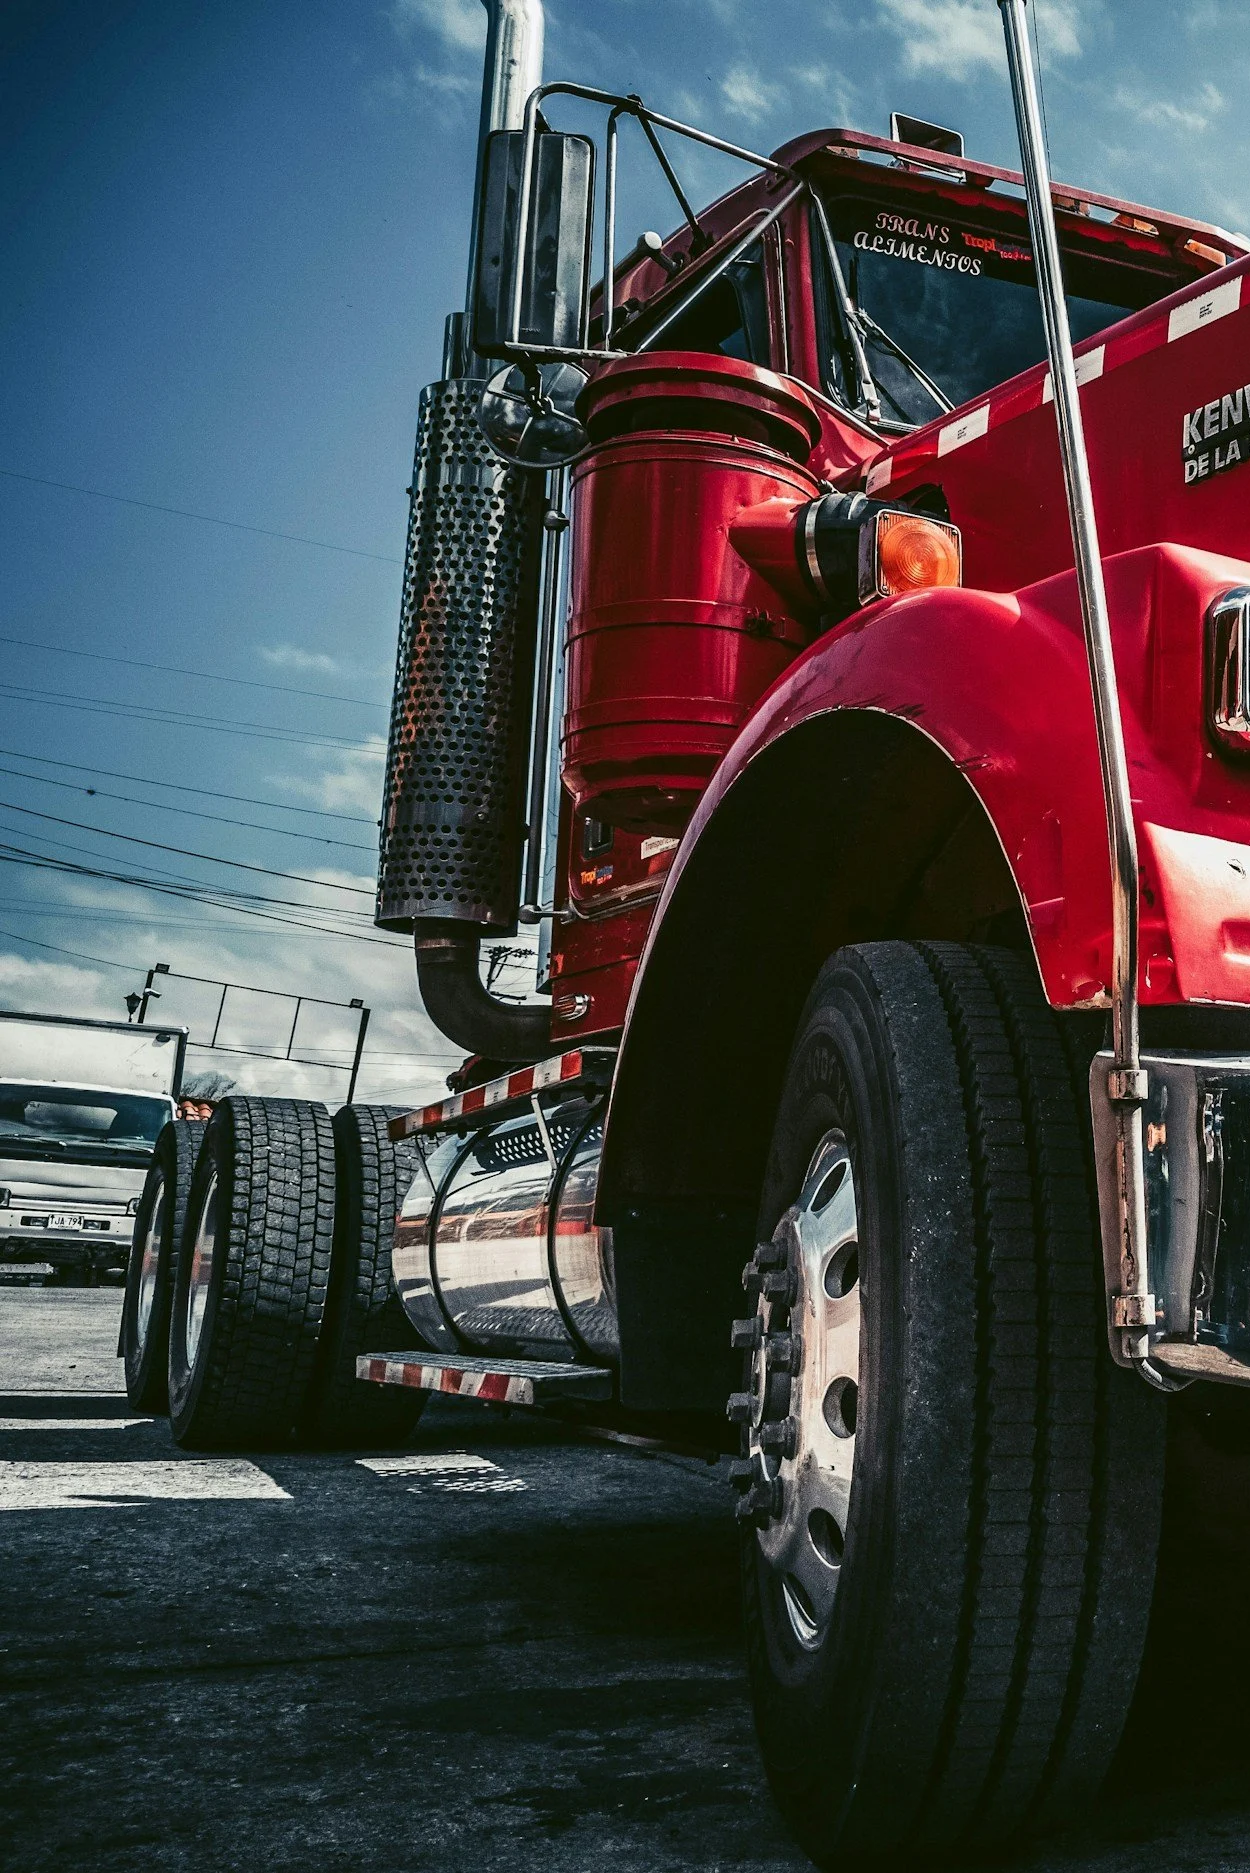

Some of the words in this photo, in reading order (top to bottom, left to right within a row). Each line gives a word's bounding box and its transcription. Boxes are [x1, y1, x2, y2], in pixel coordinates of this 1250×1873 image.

[875, 212, 950, 244] TRANS
[853, 231, 982, 276] ALIMENTOS
[1184, 452, 1209, 484] DE
[1214, 439, 1241, 470] LA
